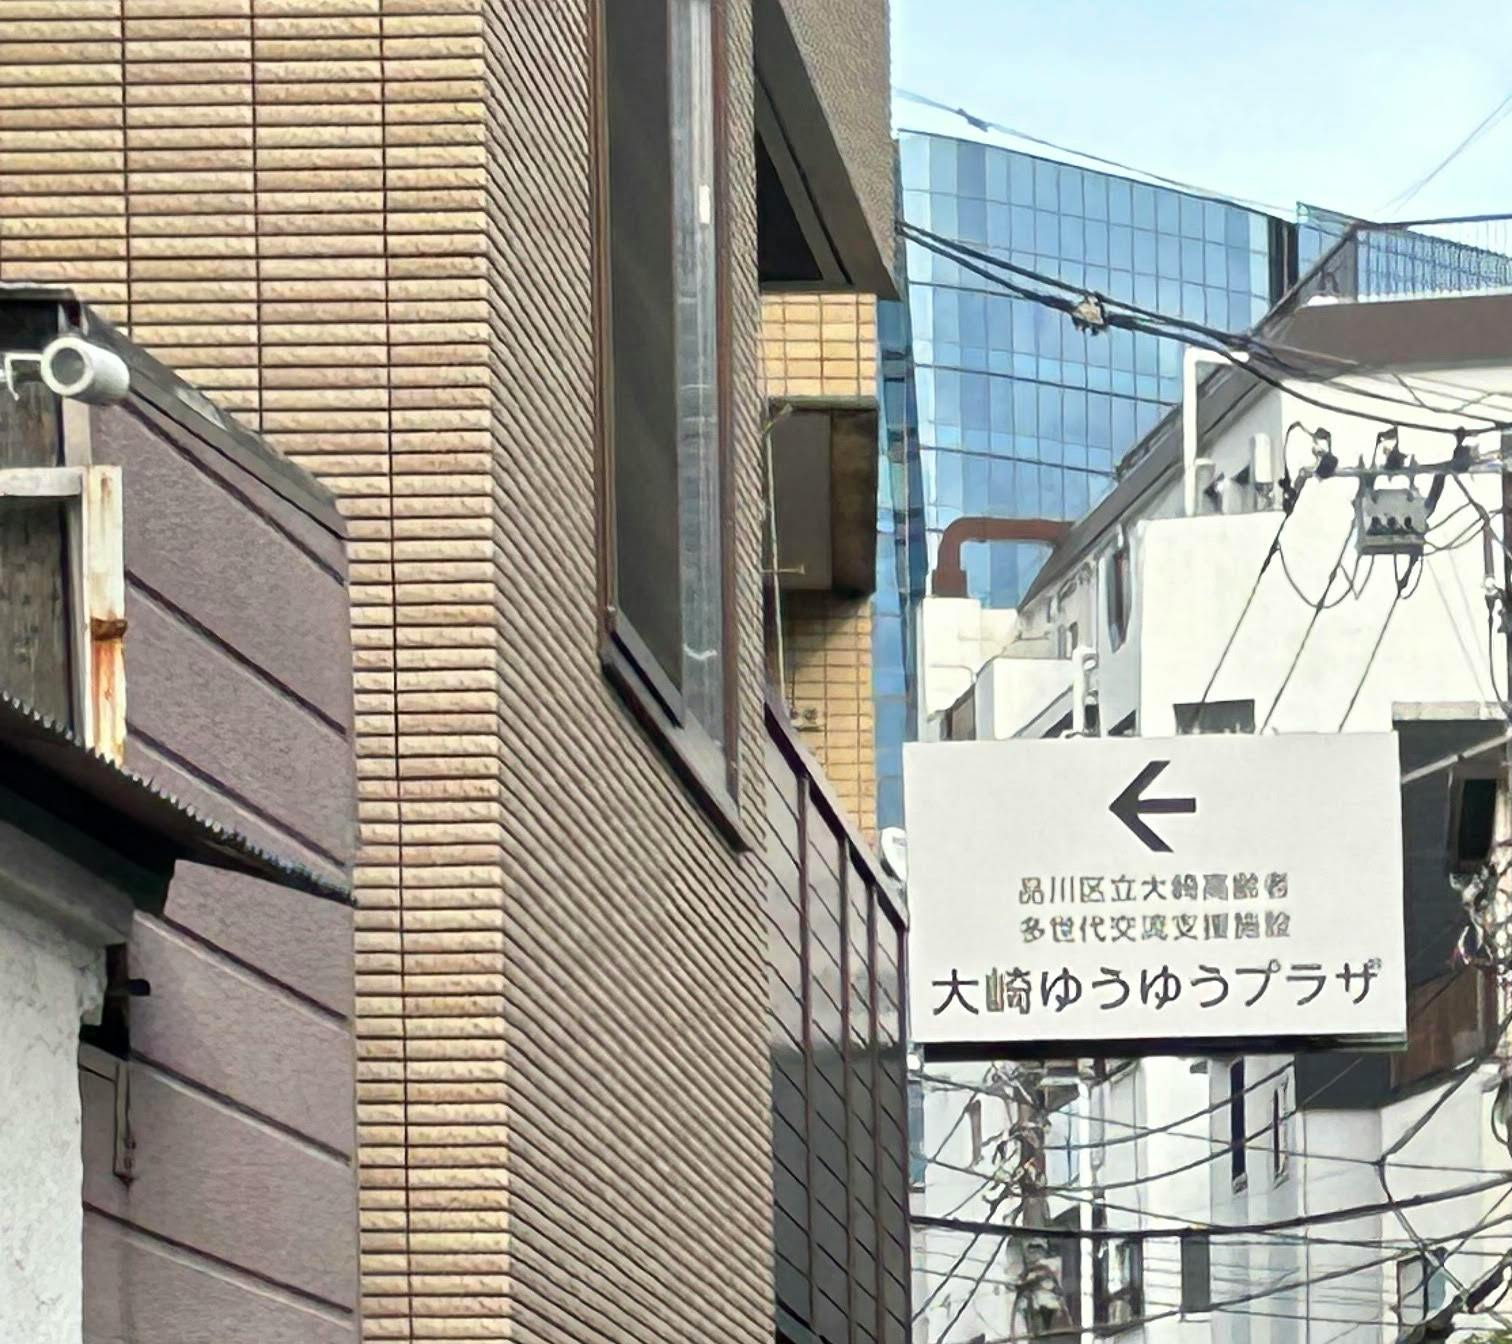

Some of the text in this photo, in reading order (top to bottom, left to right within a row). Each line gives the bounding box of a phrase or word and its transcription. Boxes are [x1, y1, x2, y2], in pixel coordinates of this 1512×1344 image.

[1018, 870, 1289, 905] 品川区立大崎高齢者
[931, 957, 1383, 1016] 大崎ゆうゆうプラザ
